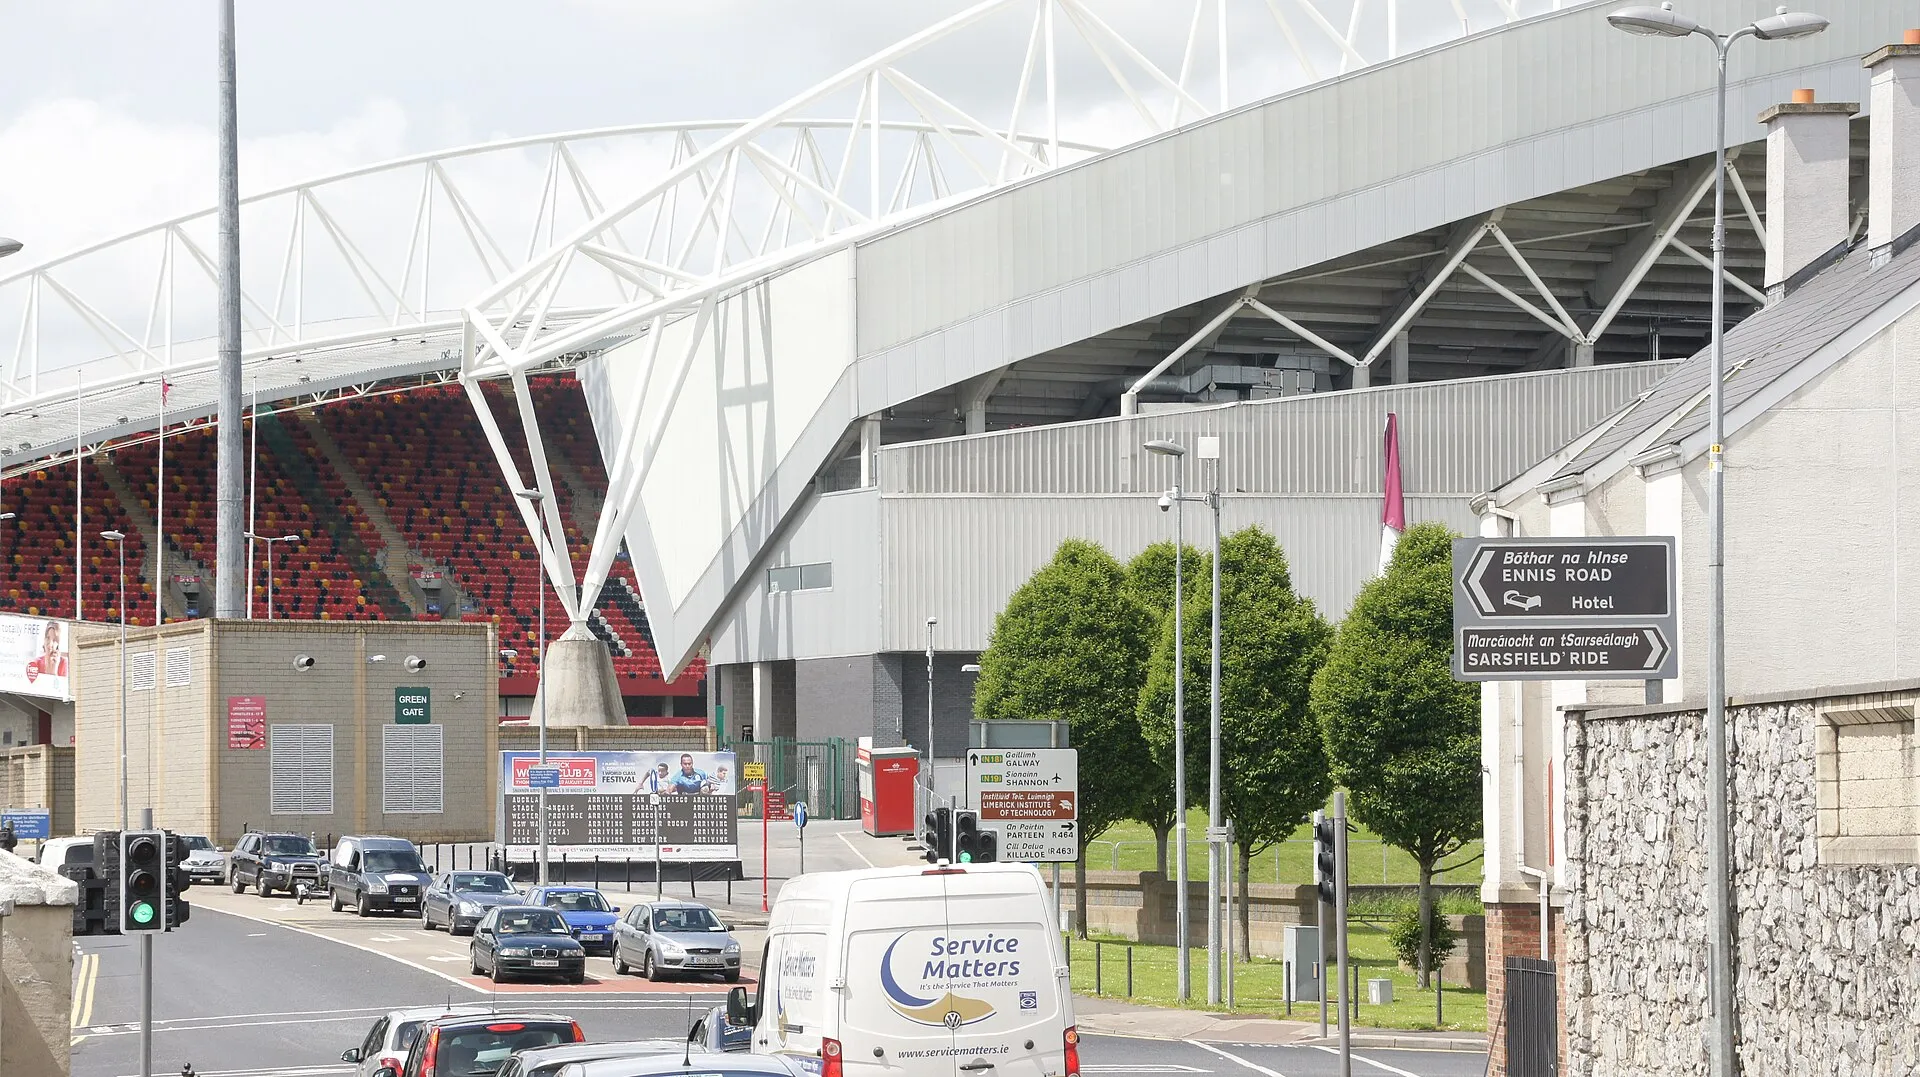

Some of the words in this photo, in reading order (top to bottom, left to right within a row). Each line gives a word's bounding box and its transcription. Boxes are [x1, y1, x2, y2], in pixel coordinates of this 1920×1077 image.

[1503, 551, 1554, 565] Bóthar
[1561, 554, 1580, 564] na
[1588, 551, 1628, 564] hInse
[1502, 568, 1556, 582] ENNIS
[1566, 568, 1612, 582] ROAD
[1572, 596, 1614, 609] Hotel
[25, 624, 40, 634] FREE
[1540, 636, 1554, 648] an
[1570, 652, 1608, 665] RIDE
[398, 696, 427, 704] GREEN
[559, 768, 581, 778] CLUB
[931, 933, 1018, 956] Service
[922, 959, 1020, 979] Matters
[898, 1045, 1009, 1058] www.servicematters.ie
